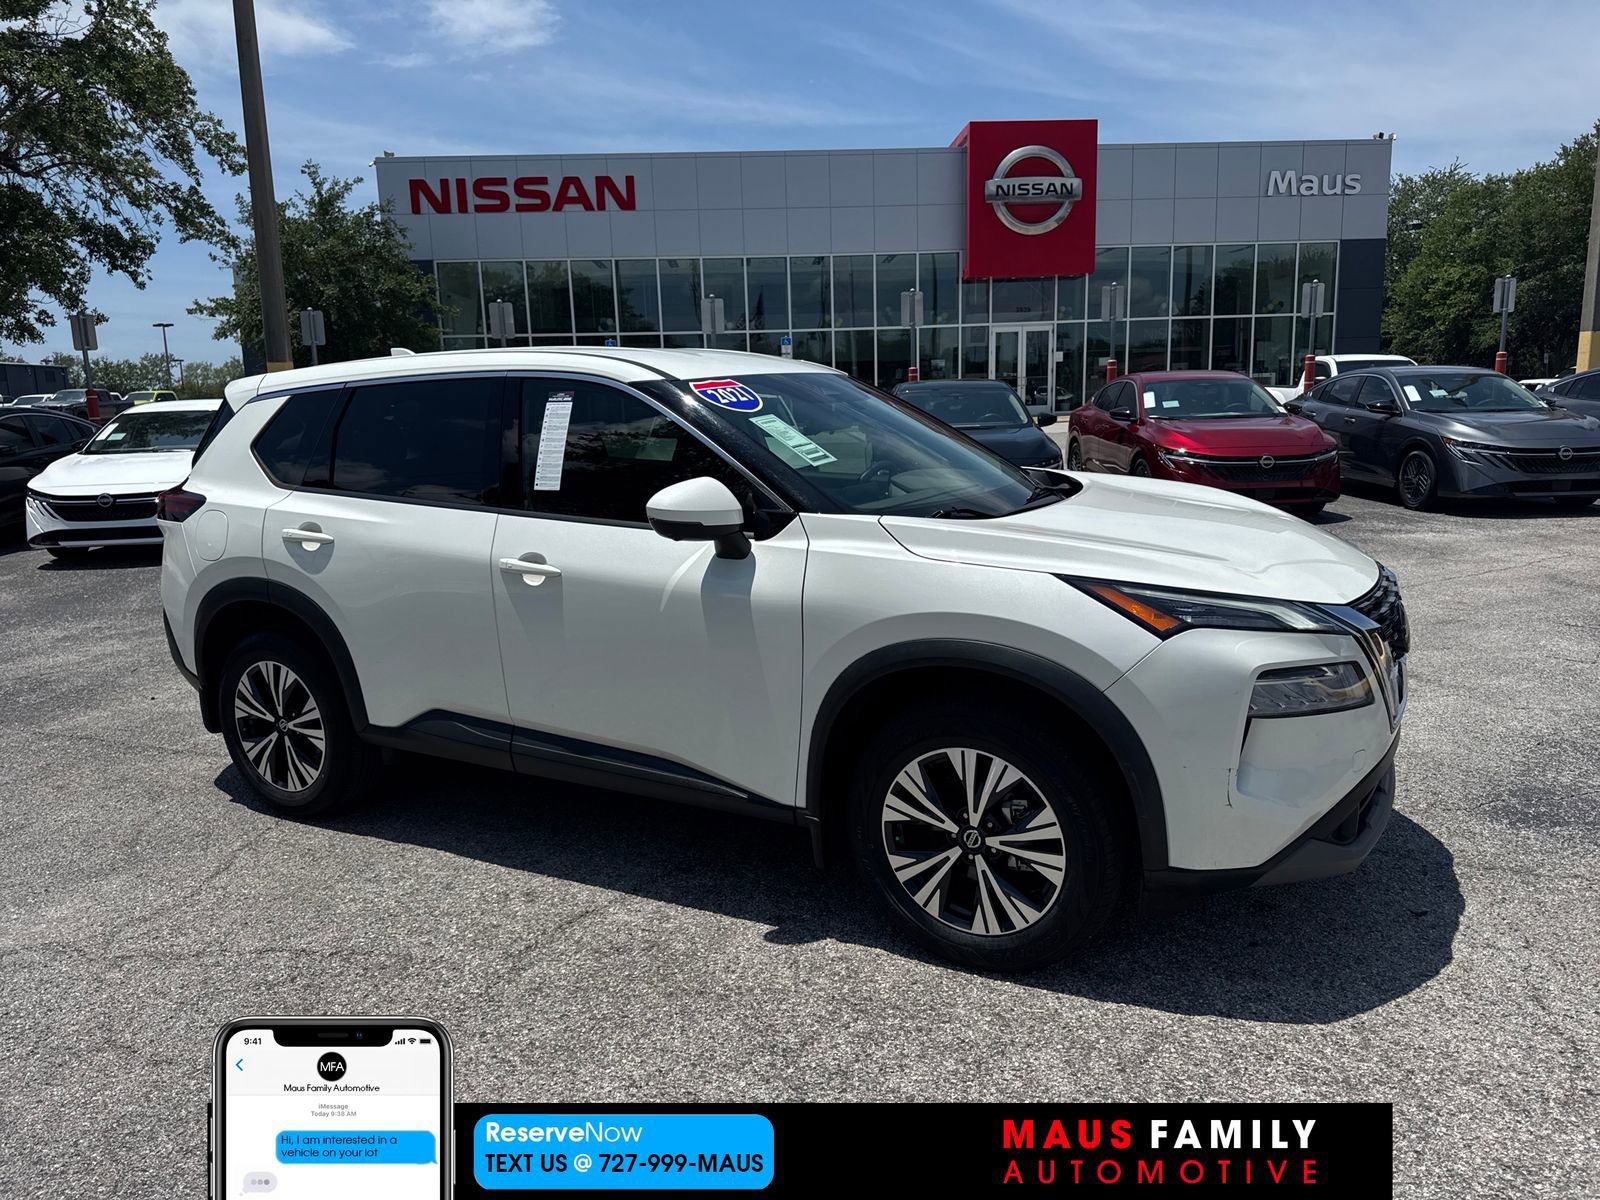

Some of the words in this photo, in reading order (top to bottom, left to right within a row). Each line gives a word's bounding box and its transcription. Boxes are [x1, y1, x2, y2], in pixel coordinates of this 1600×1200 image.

[995, 182, 1073, 197] NISSAN
[1267, 170, 1361, 196] Maus
[408, 175, 636, 215] NISSAN
[706, 387, 755, 404] 2021
